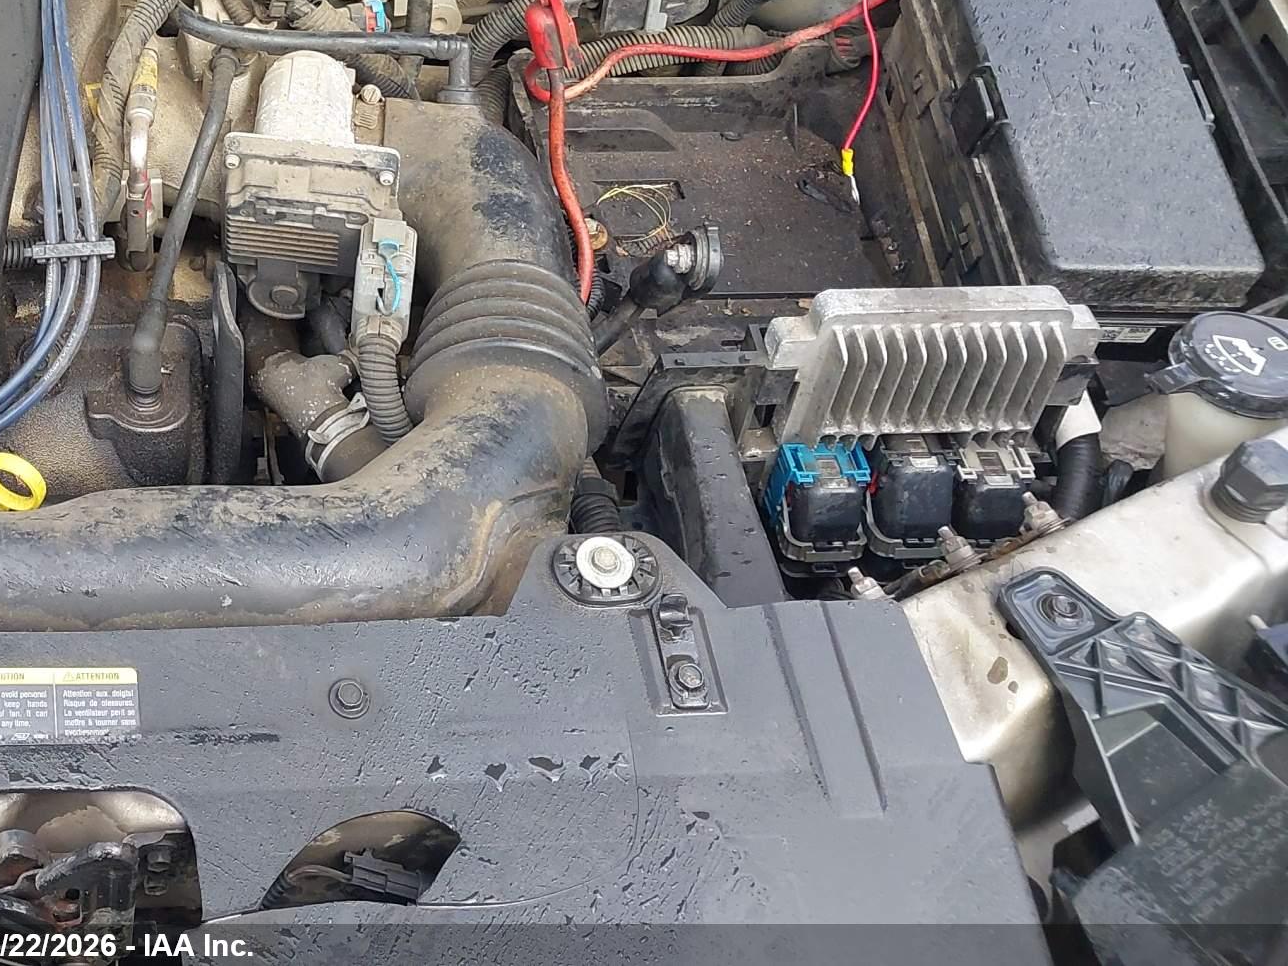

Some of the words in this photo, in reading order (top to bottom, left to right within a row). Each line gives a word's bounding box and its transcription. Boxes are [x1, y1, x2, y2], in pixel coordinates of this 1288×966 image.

[76, 672, 120, 681] ATTENTION
[1, 690, 18, 698] avoid
[63, 690, 92, 698] Attention
[4, 700, 21, 709] keep
[27, 700, 48, 708] hands
[35, 710, 48, 718] can
[1, 721, 13, 729] any
